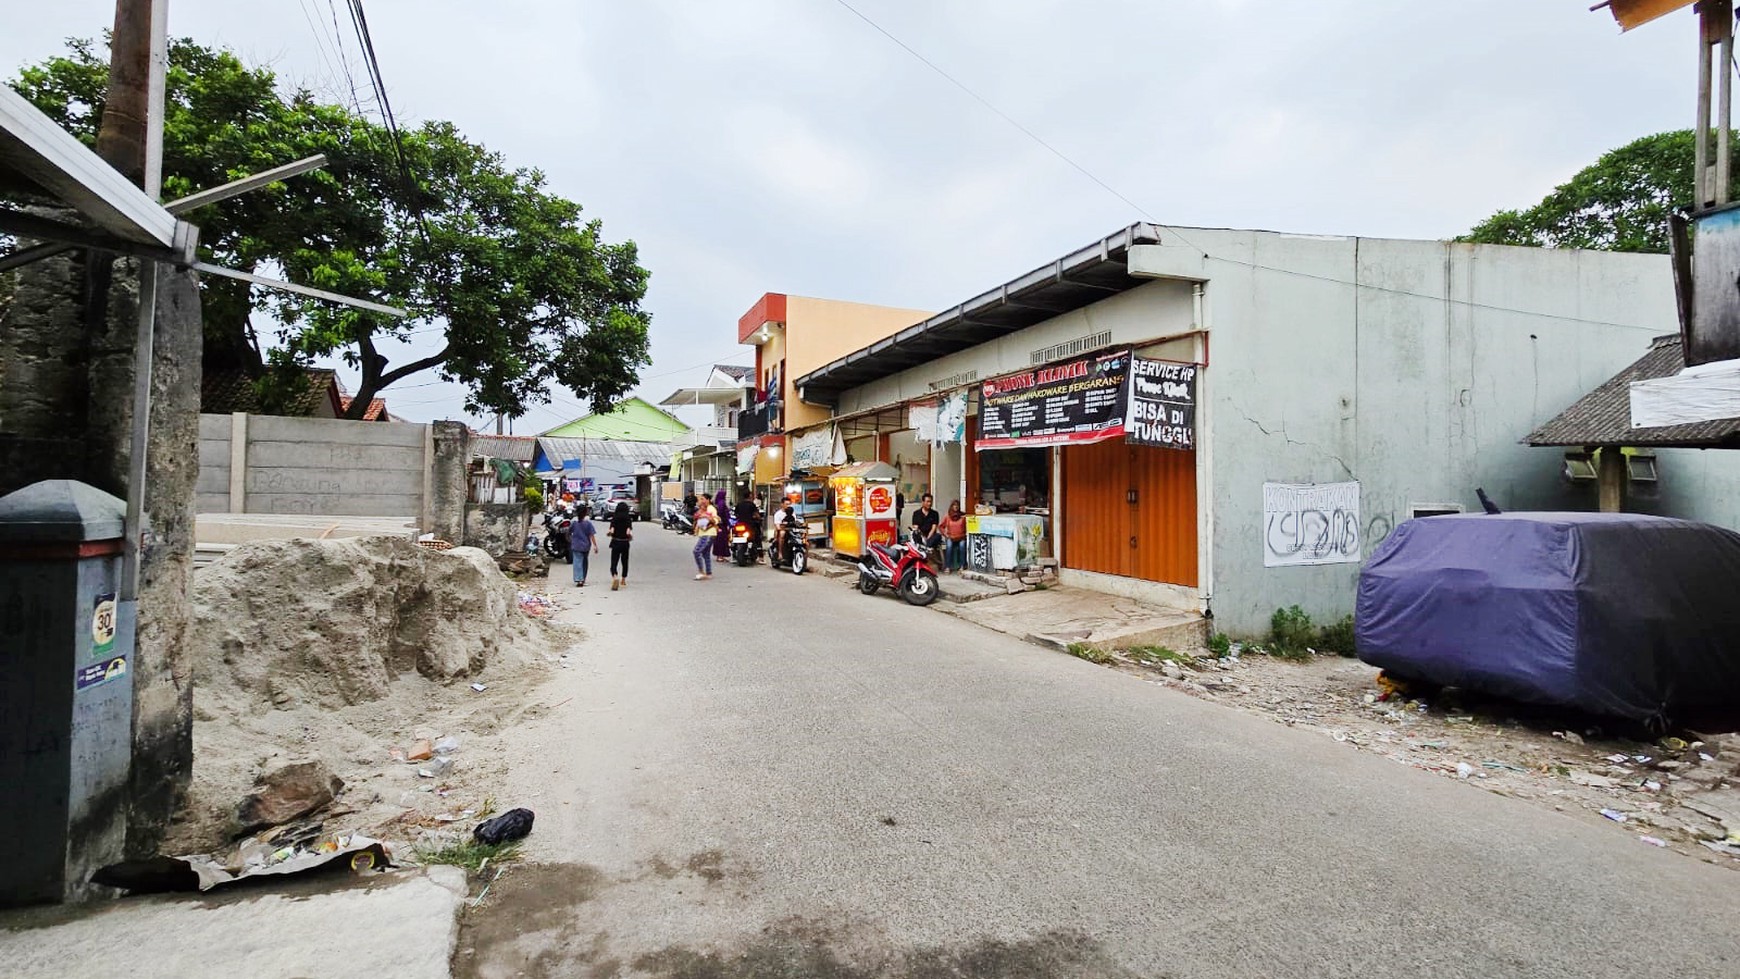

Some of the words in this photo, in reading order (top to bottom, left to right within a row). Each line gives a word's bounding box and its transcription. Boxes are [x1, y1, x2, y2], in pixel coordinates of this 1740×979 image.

[1133, 360, 1179, 380] SERVICE
[1180, 367, 1195, 382] HP
[1027, 385, 1067, 400] HARDWARE
[1134, 401, 1166, 421] BISA
[1171, 410, 1184, 425] DI
[97, 612, 111, 630] 30
